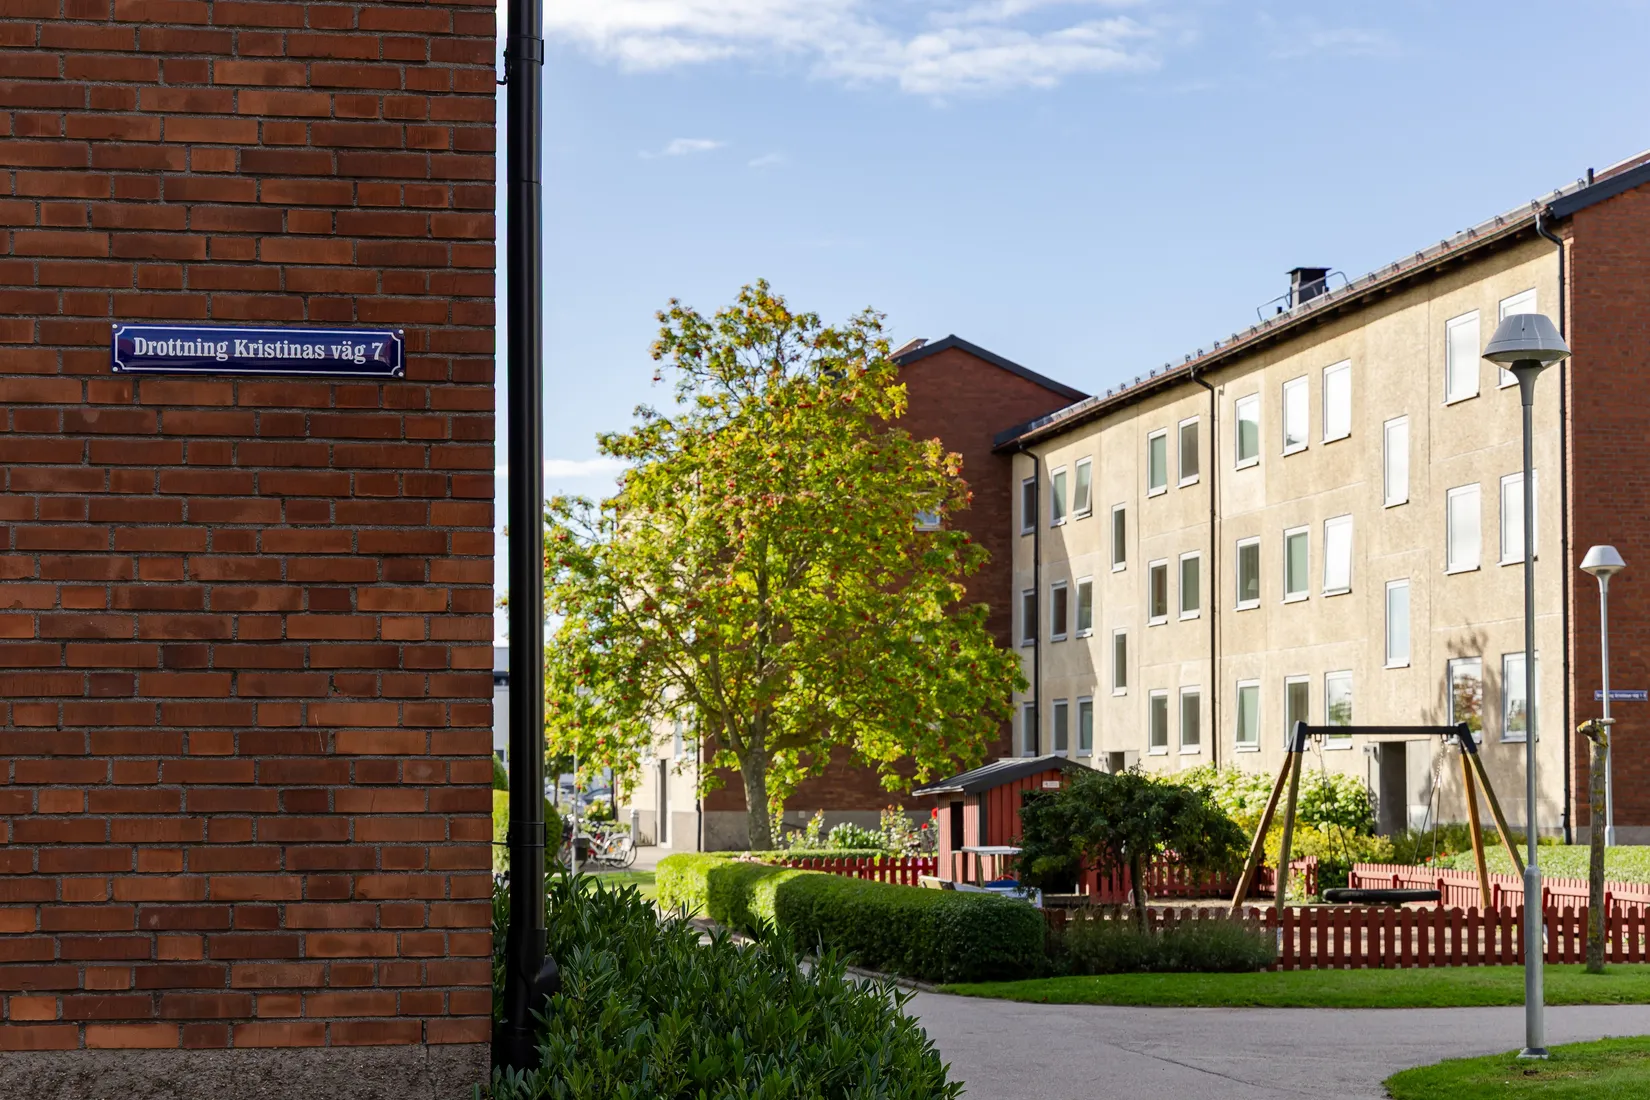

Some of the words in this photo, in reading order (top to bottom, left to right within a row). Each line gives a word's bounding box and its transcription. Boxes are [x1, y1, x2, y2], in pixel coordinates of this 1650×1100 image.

[133, 337, 229, 362] Drottning
[234, 339, 325, 360] Kristinas
[331, 342, 367, 365] väg
[372, 342, 384, 361] 7
